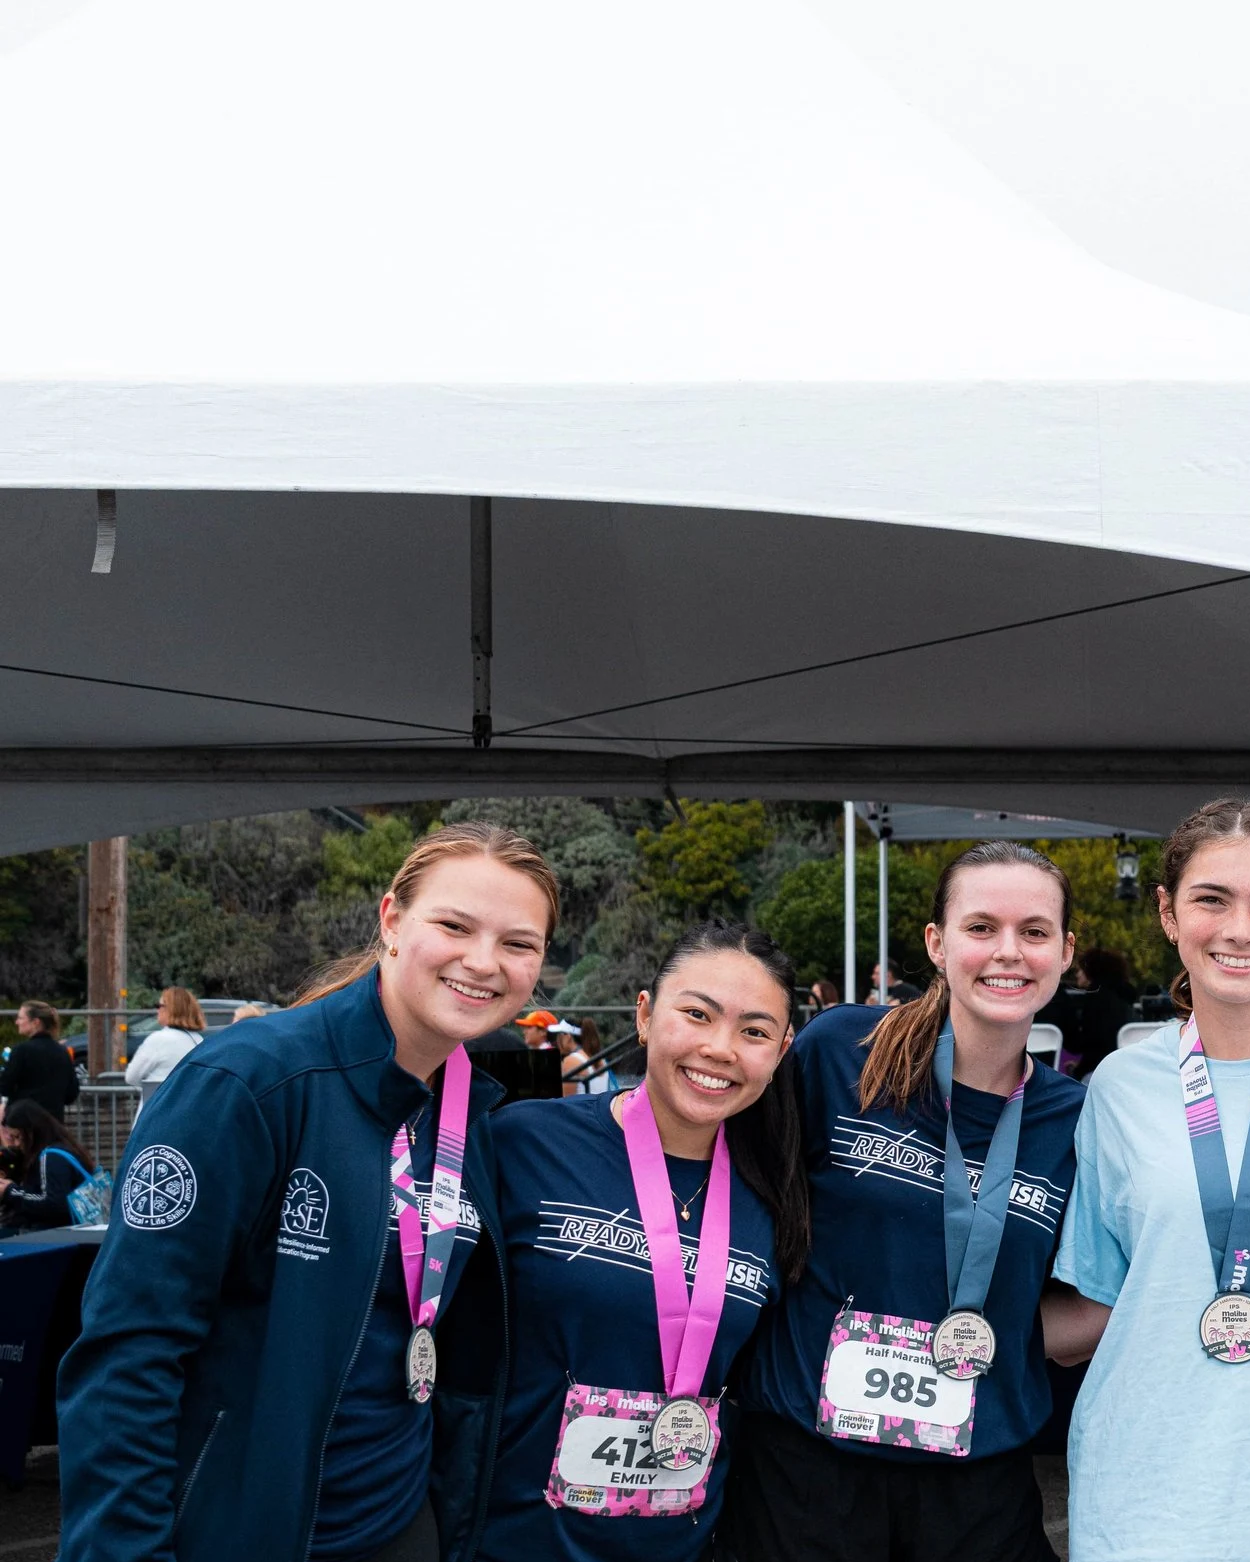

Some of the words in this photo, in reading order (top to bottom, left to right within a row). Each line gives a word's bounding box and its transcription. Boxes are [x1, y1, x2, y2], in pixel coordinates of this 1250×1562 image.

[1009, 1182, 1047, 1211] ISE!
[166, 1206, 186, 1222] Skills
[429, 1257, 443, 1274] 5K
[726, 1261, 761, 1291] ISE!
[850, 1320, 870, 1332] IPS
[865, 1347, 889, 1358] Half
[892, 1352, 934, 1366] Marath
[864, 1368, 938, 1408] 985
[585, 1394, 608, 1406] IPS
[839, 1414, 875, 1424] Founding
[637, 1424, 651, 1434] 5K
[610, 1472, 657, 1485] EMILY
[569, 1488, 604, 1498] Founding
